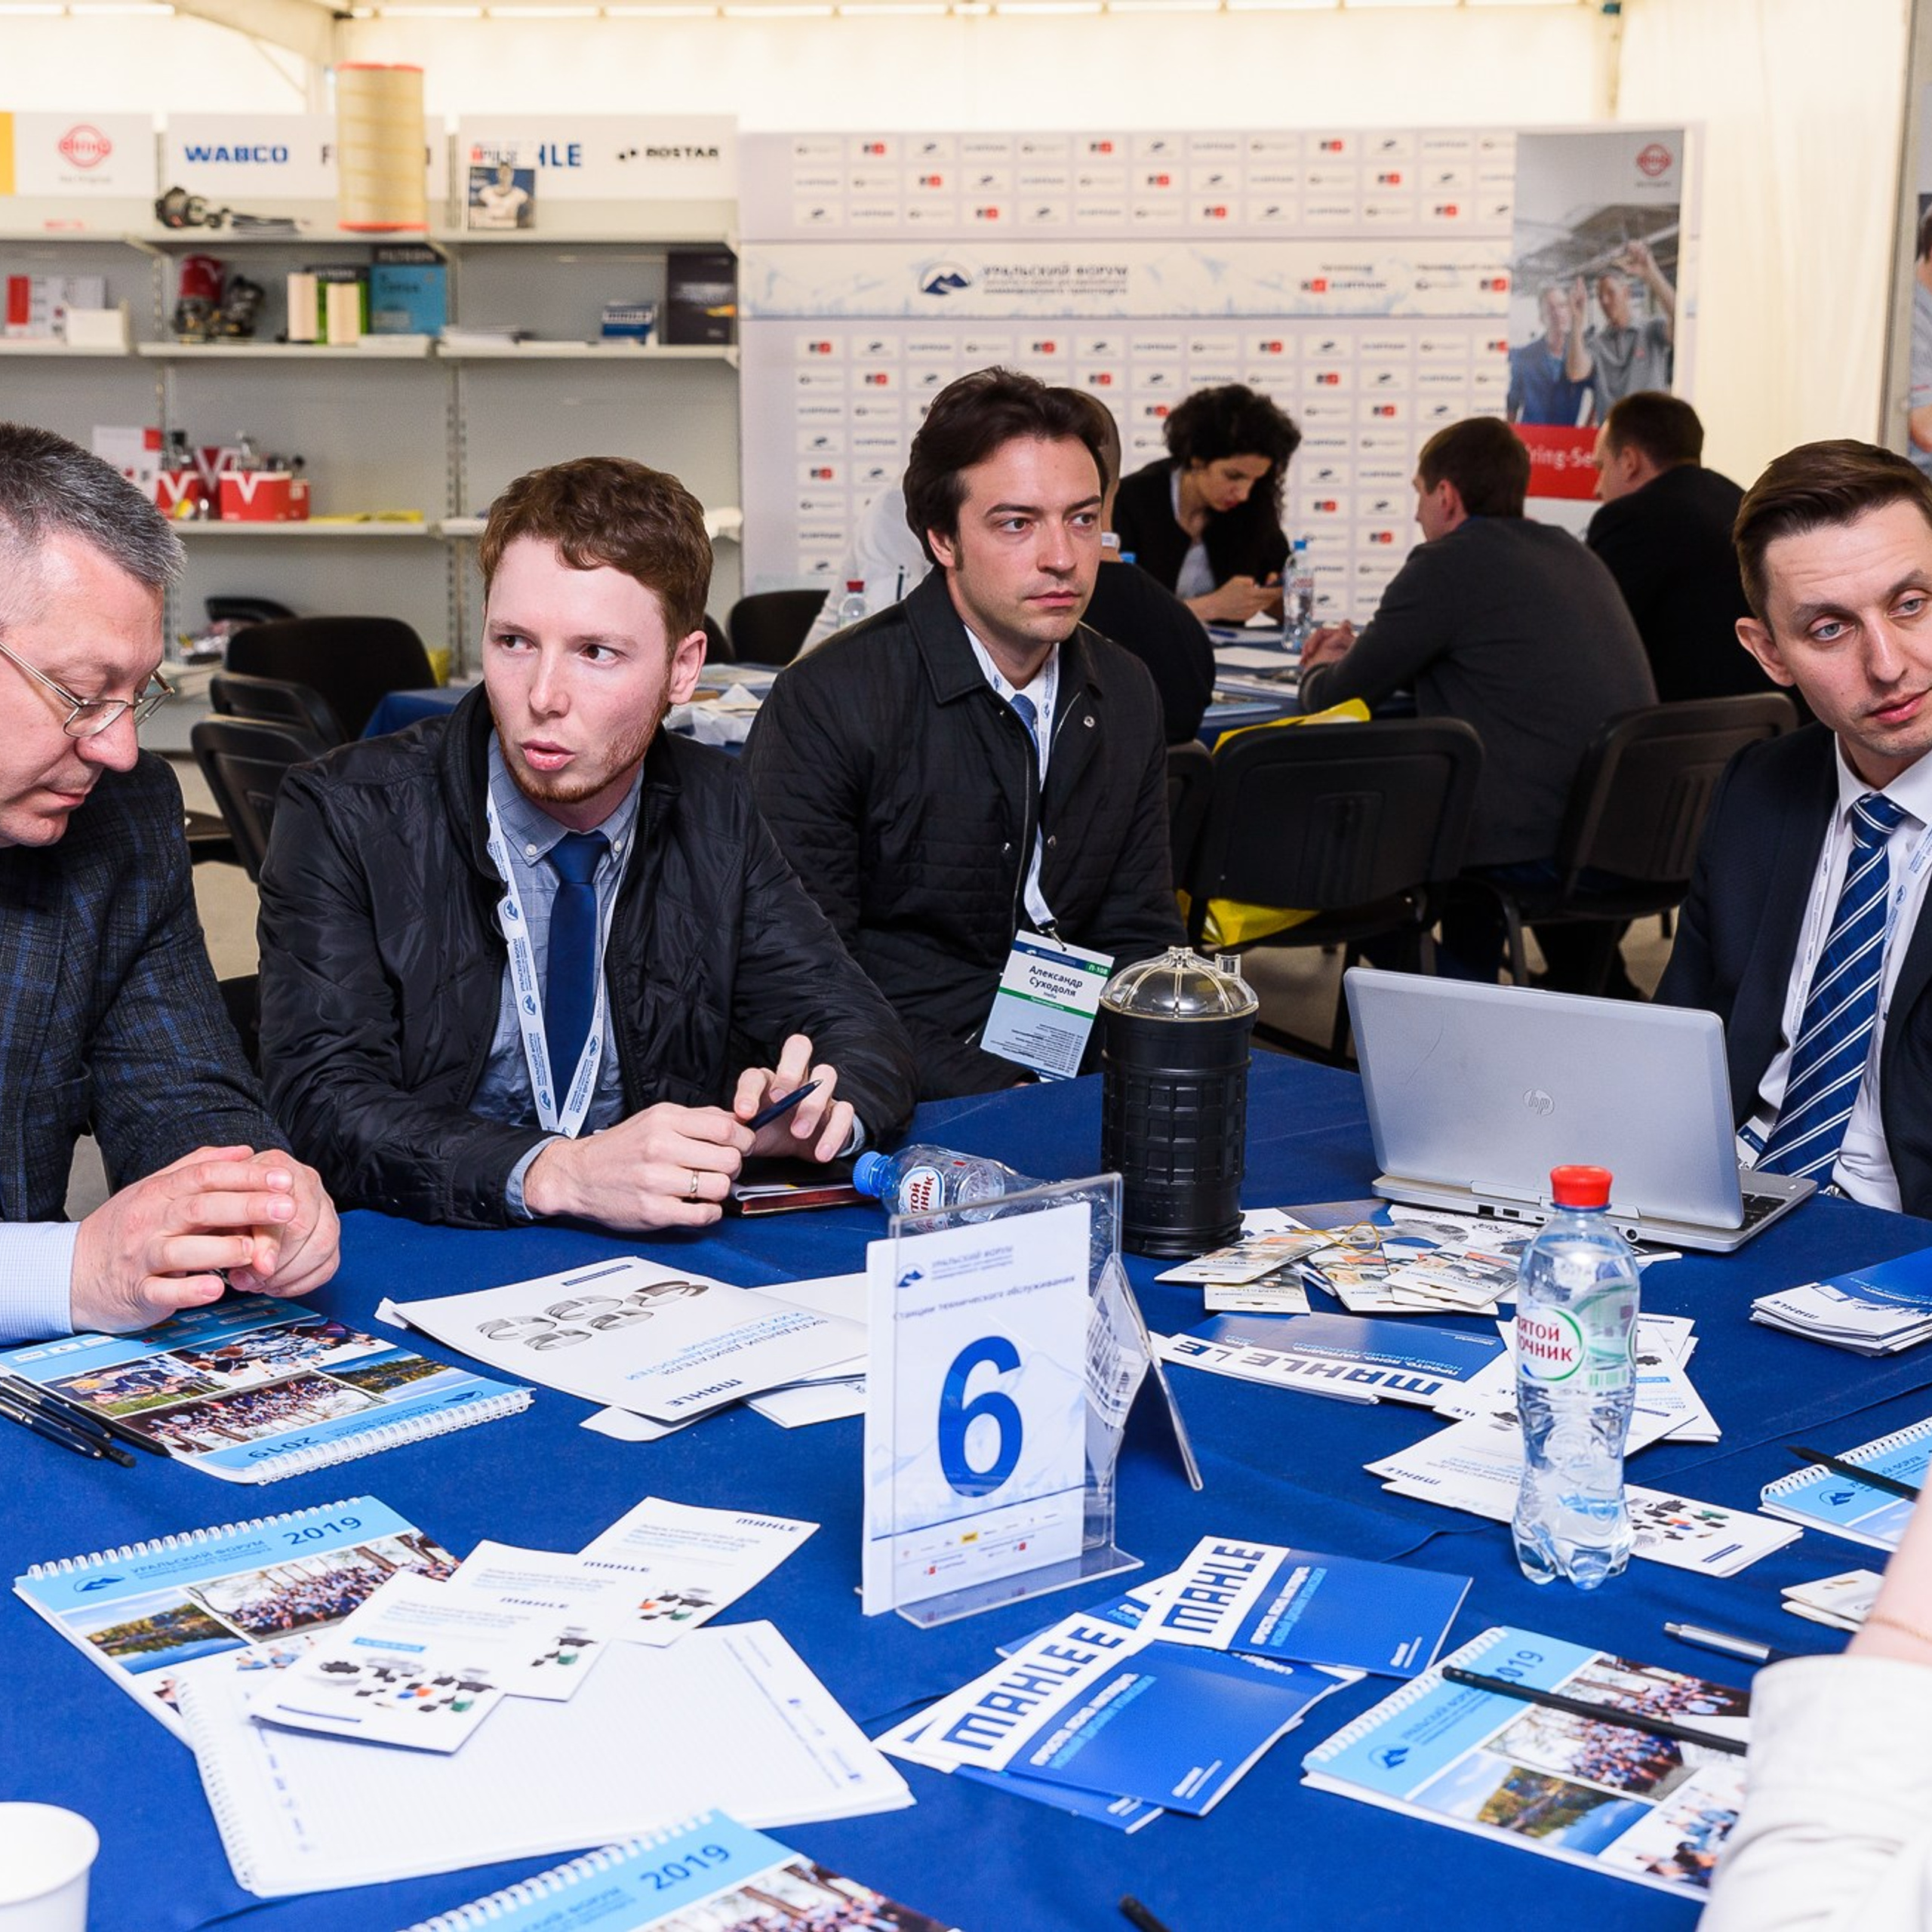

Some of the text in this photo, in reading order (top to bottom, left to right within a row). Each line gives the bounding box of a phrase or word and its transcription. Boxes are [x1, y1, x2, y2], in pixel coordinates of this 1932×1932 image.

[184, 145, 288, 163] WABCO
[645, 146, 720, 158] ROSTAR
[1029, 965, 1083, 989] Александр
[1029, 977, 1077, 998] Суходоля
[894, 1275, 1075, 1321] Станции технического обслуживания
[1770, 1300, 1819, 1319] MAHLE
[1241, 1353, 1443, 1395] MAHLE
[666, 1379, 742, 1408] MAHLE
[938, 1334, 1023, 1500] 6
[247, 1436, 318, 1461] 2019
[1383, 1467, 1441, 1485] MAHLE
[282, 1515, 362, 1546] 2019
[736, 1517, 801, 1533] MAHLE
[583, 1560, 651, 1574] MAHLE
[1160, 1543, 1266, 1634] MAHLE
[499, 1596, 569, 1609] MAHLE
[1496, 1650, 1545, 1684] 019
[640, 1843, 731, 1893] 2019
